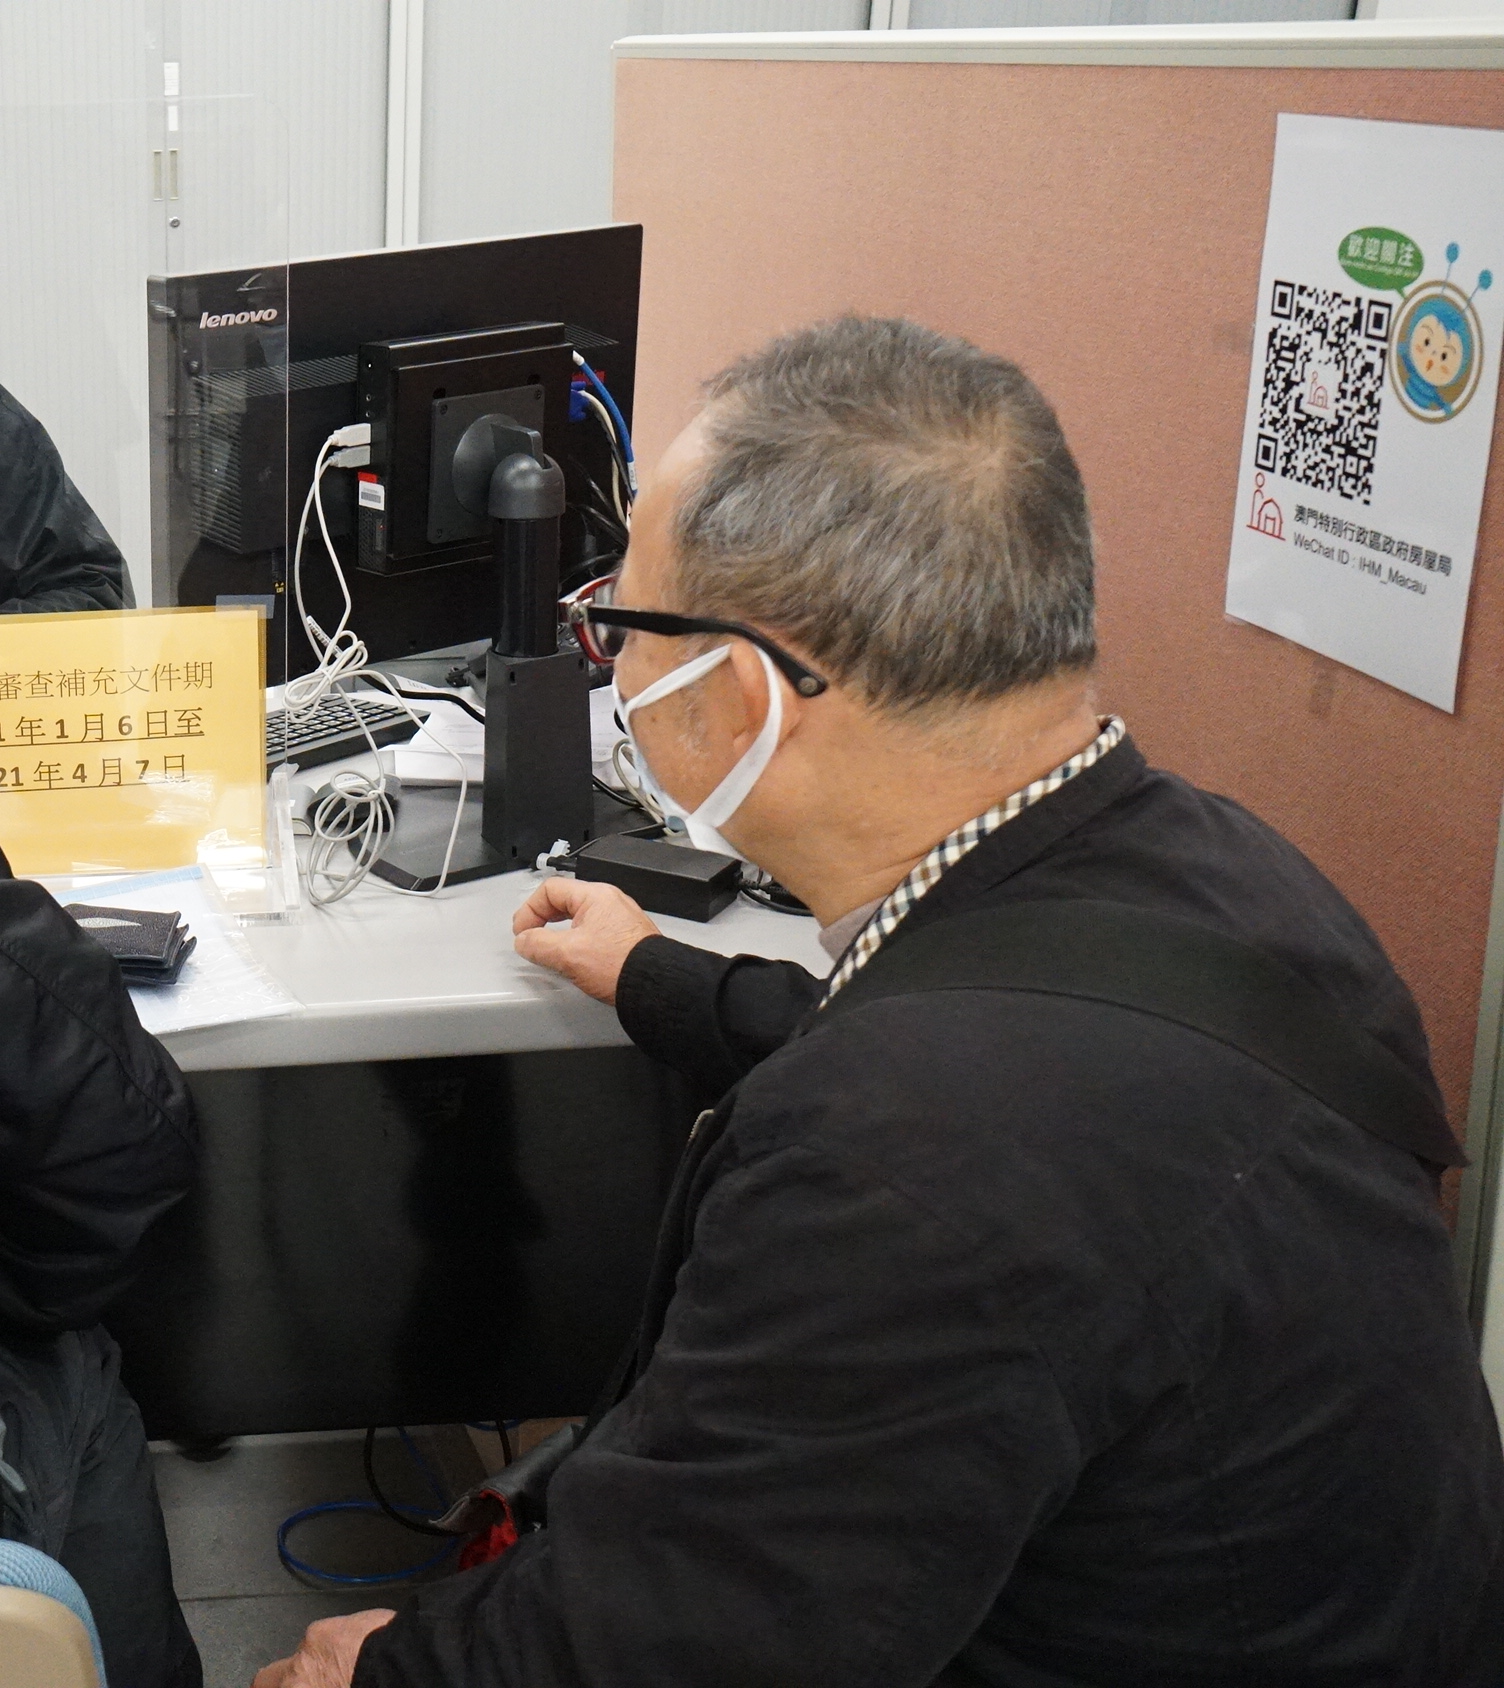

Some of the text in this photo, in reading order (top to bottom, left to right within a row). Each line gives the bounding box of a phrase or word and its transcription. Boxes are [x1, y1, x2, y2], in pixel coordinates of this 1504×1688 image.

[199, 308, 278, 329] lenovo
[1294, 504, 1453, 577] 澳門特別行政區政府房屋局
[1293, 531, 1335, 560] WeChat
[1337, 548, 1350, 565] ID
[1358, 556, 1428, 595] IHM_Macau
[15, 716, 46, 745] 年
[55, 719, 69, 739] 1
[81, 713, 104, 743] 月
[118, 715, 133, 736] 6
[146, 707, 205, 737] 日至
[33, 761, 64, 789] 年
[72, 763, 88, 783] 4
[99, 757, 122, 787] 月
